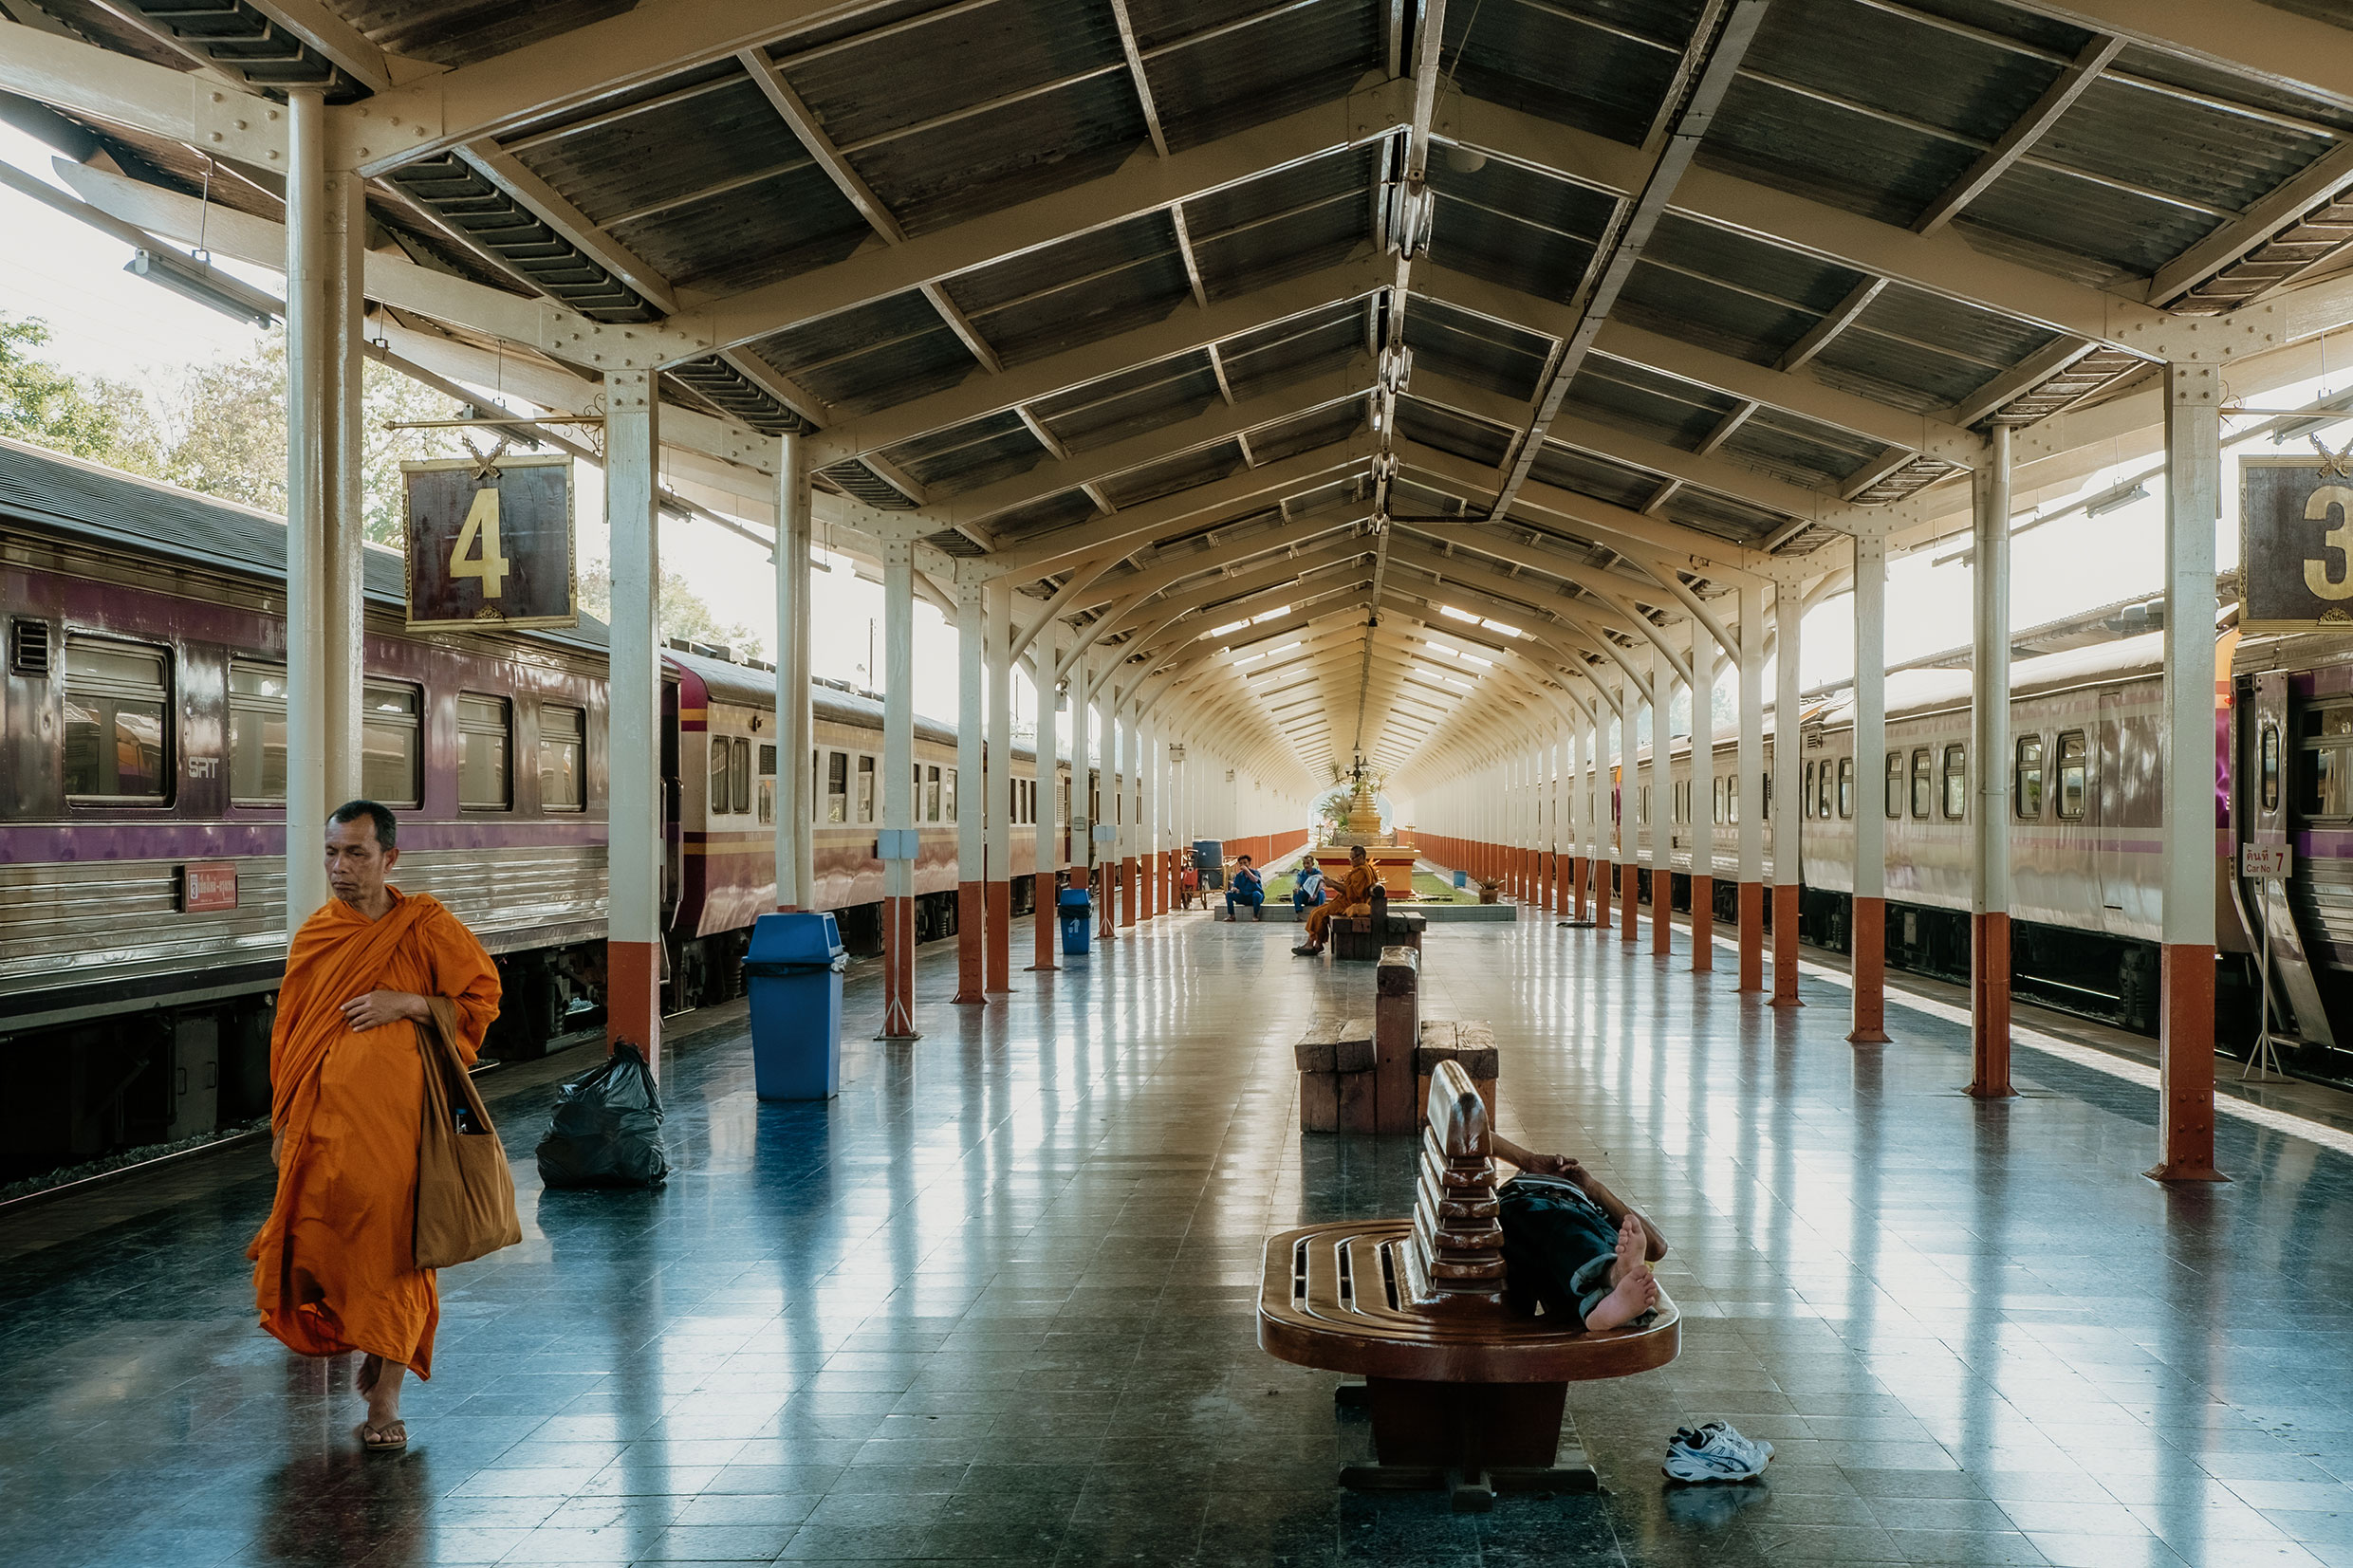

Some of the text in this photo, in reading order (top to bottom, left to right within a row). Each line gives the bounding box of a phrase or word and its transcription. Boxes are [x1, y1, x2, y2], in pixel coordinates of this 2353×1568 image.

[450, 488, 510, 599] 4
[2303, 485, 2353, 600] 3
[189, 756, 219, 779] SRT
[2247, 864, 2270, 873] Car No
[2275, 853, 2284, 872] 7
